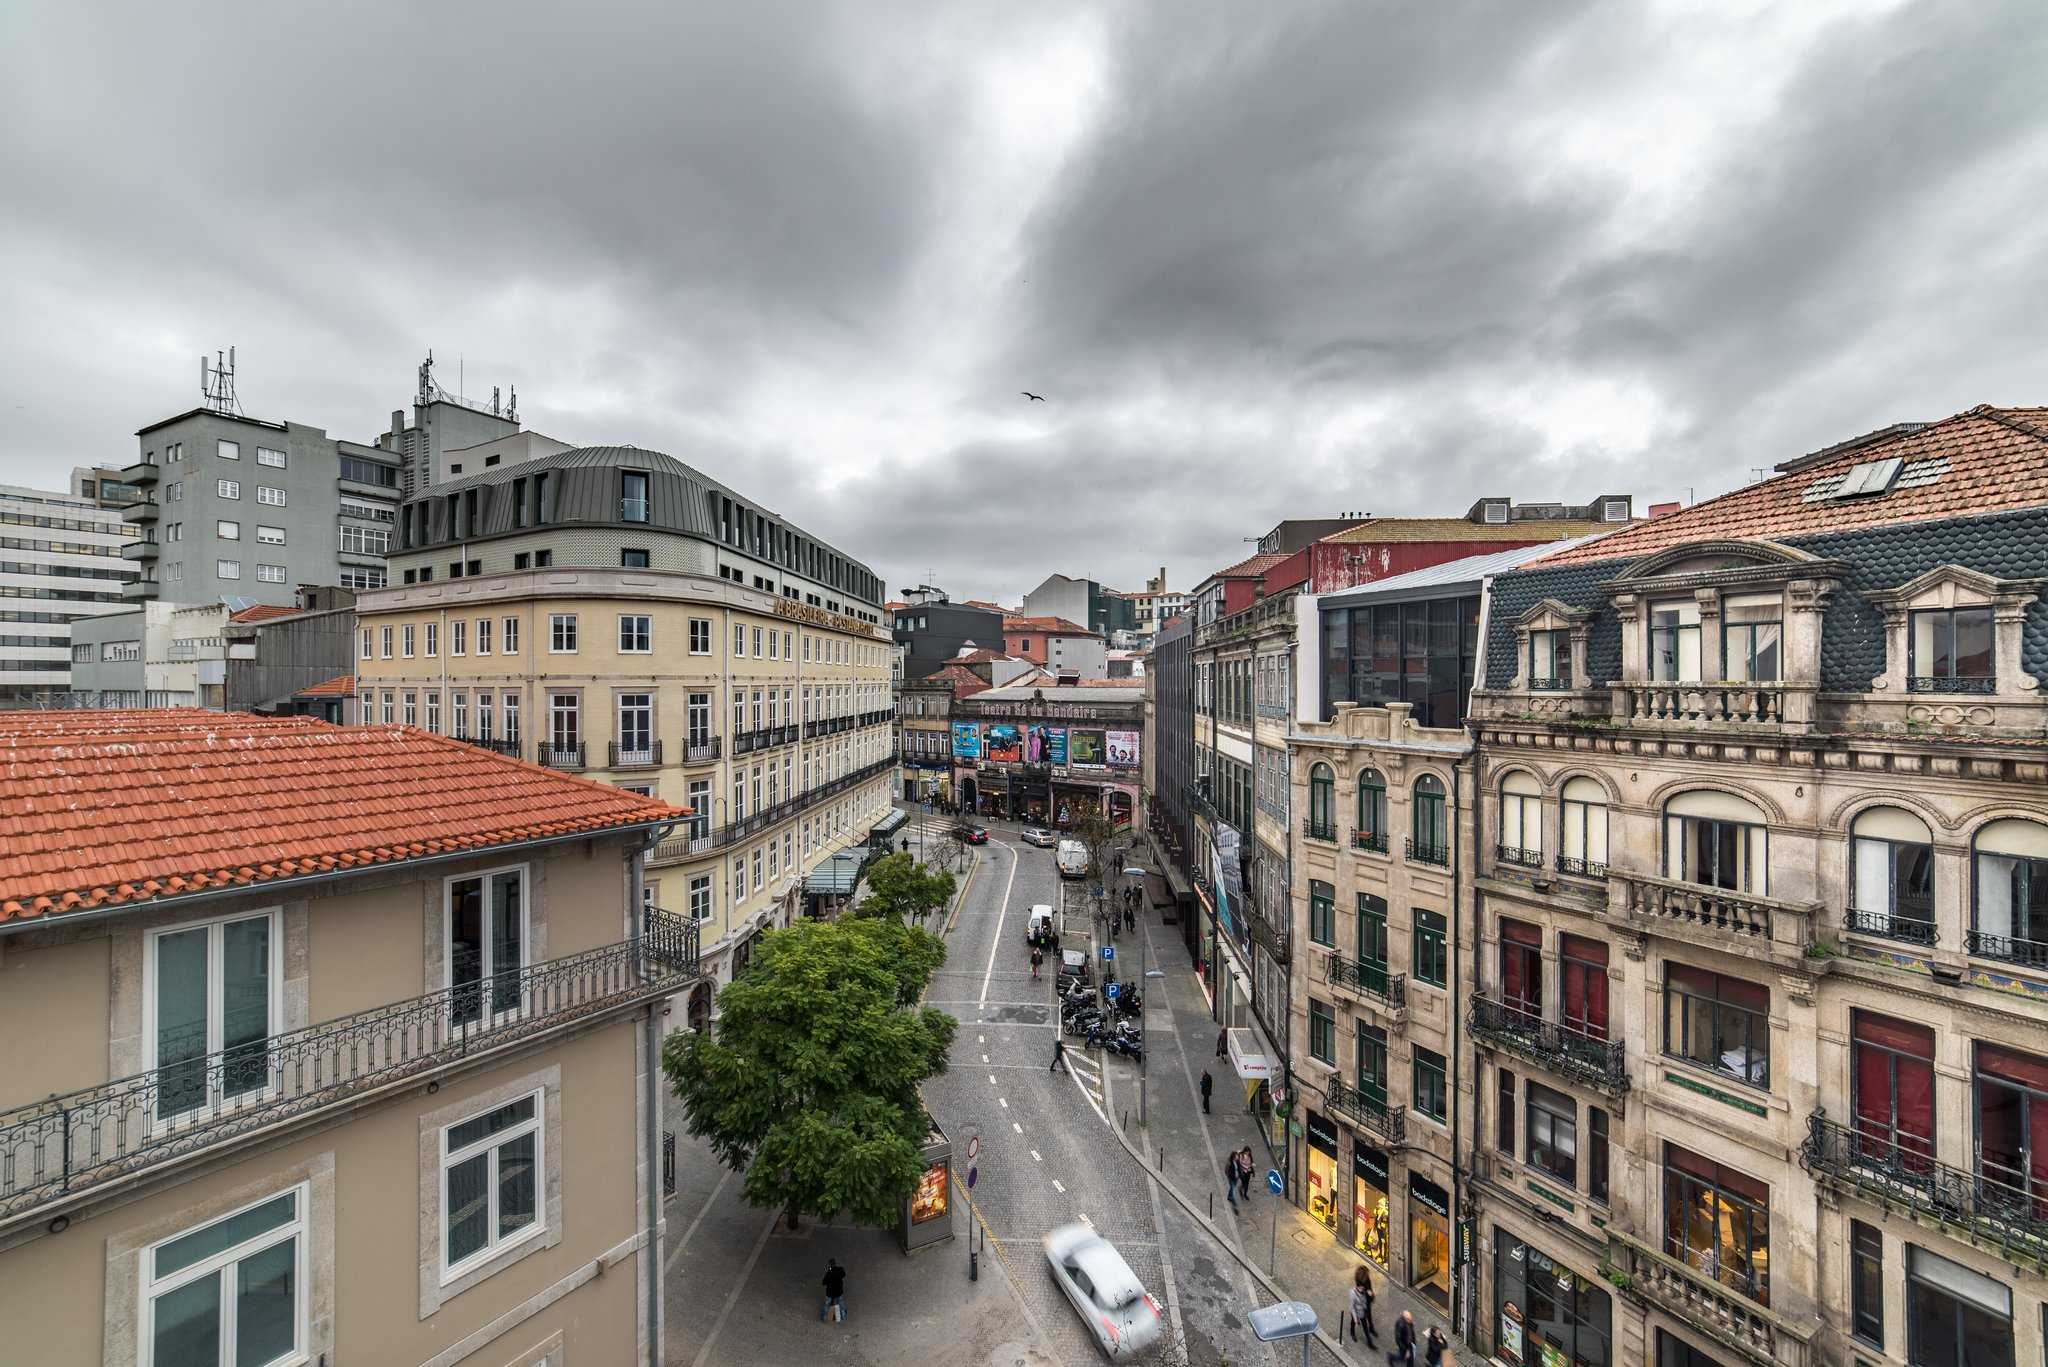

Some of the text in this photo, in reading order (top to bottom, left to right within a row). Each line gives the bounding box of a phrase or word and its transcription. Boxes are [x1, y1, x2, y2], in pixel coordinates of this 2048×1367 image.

[980, 702, 1011, 715] Teatro
[1046, 703, 1097, 719] Bandeira
[1109, 986, 1117, 997] P
